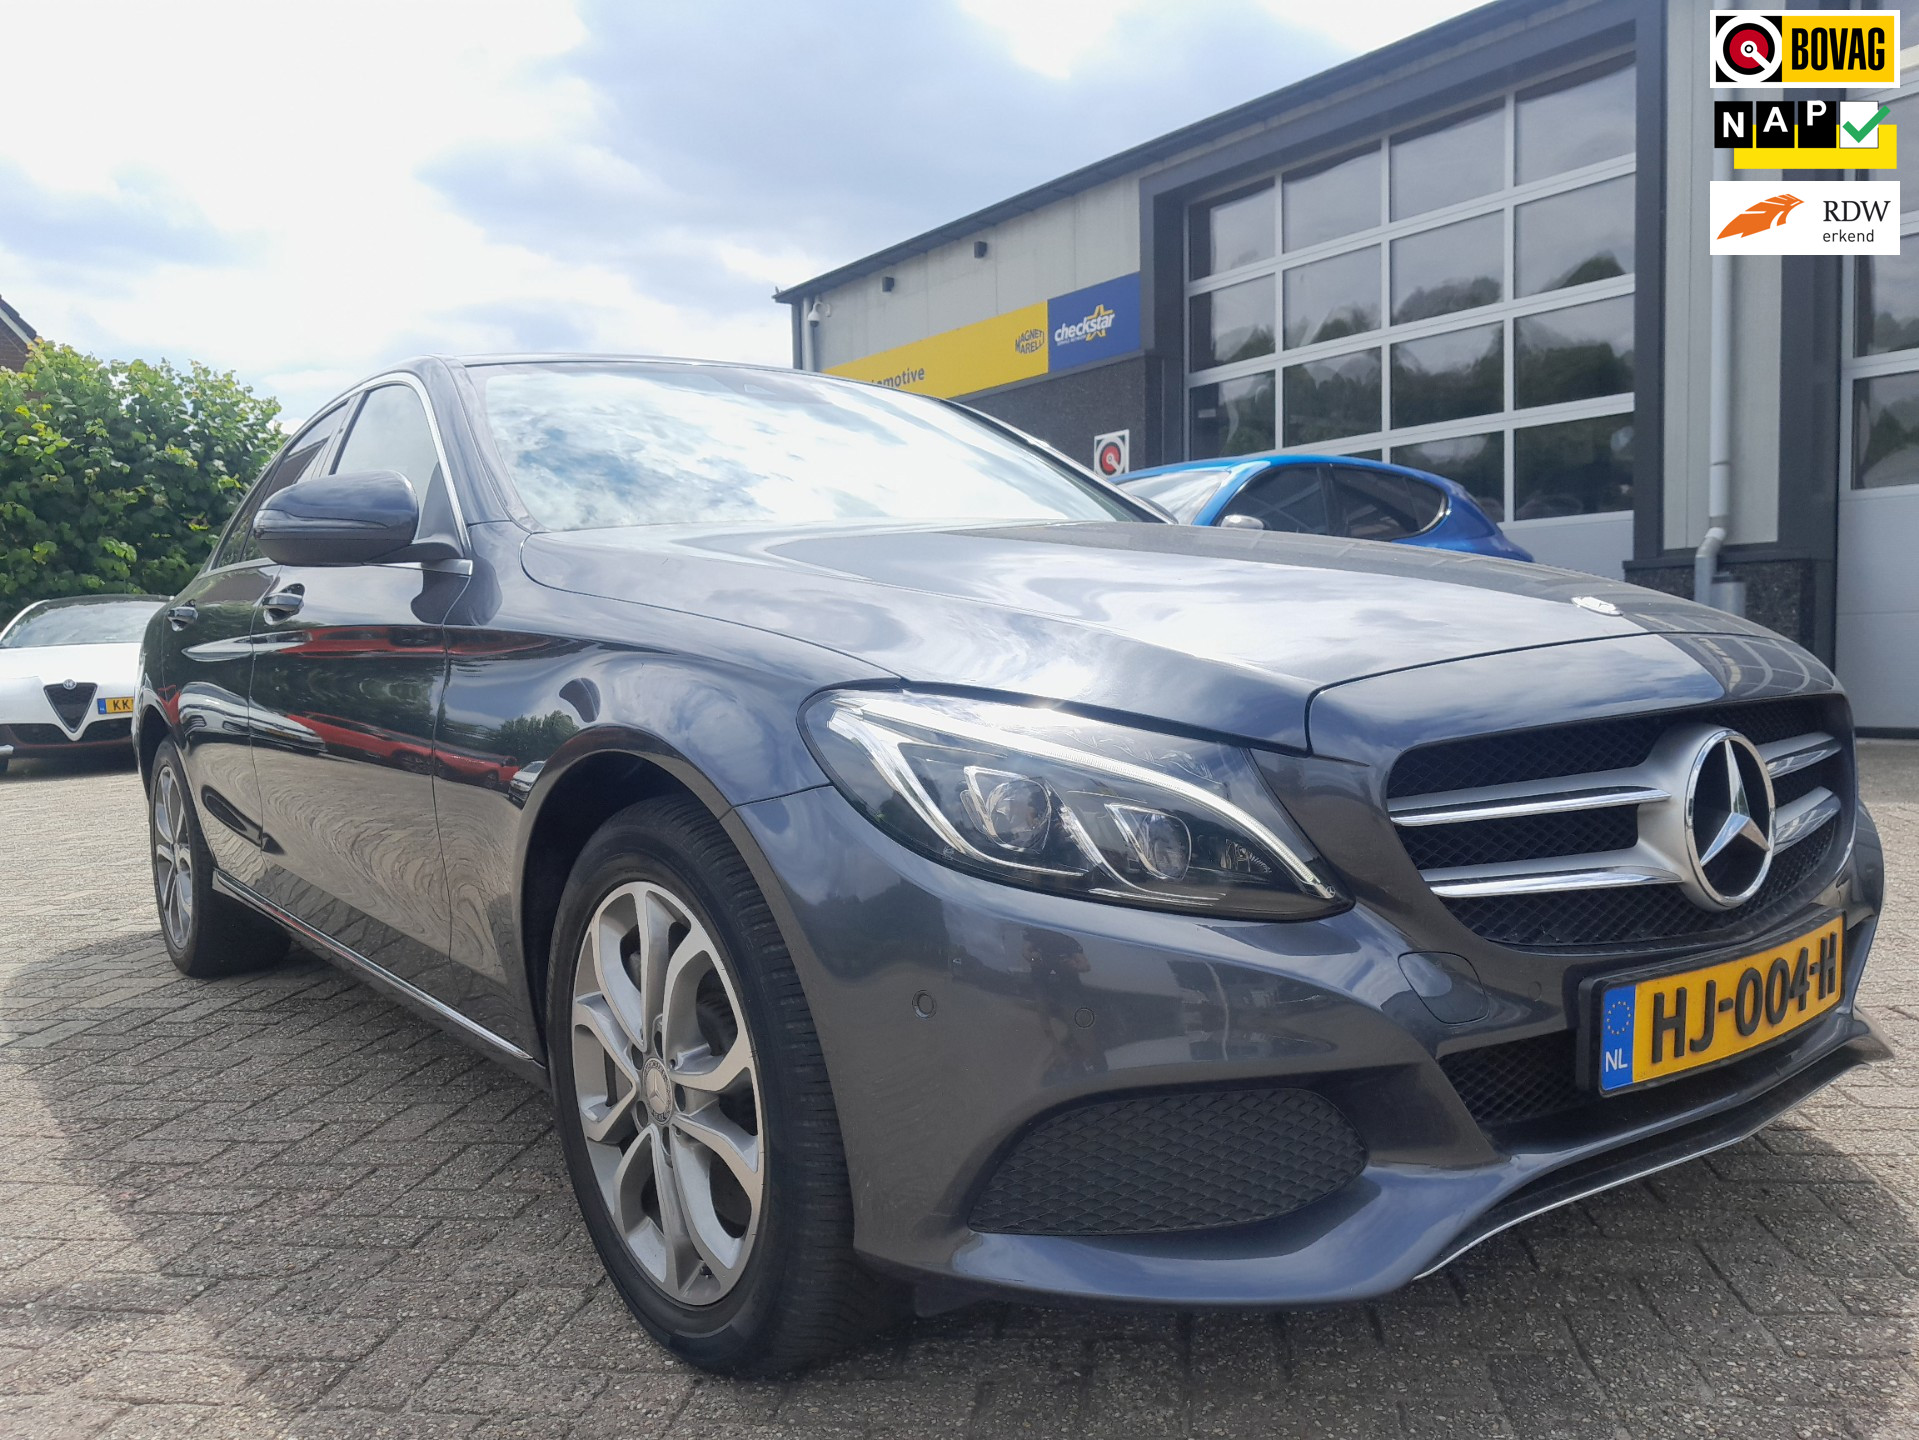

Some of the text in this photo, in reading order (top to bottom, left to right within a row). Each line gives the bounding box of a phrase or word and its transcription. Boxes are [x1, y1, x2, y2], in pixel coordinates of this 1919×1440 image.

[1054, 313, 1116, 342] checkstar
[871, 367, 925, 388] motive
[112, 699, 133, 711] KK
[1651, 931, 1838, 1064] HJ-004-H
[1604, 1048, 1629, 1073] NL
